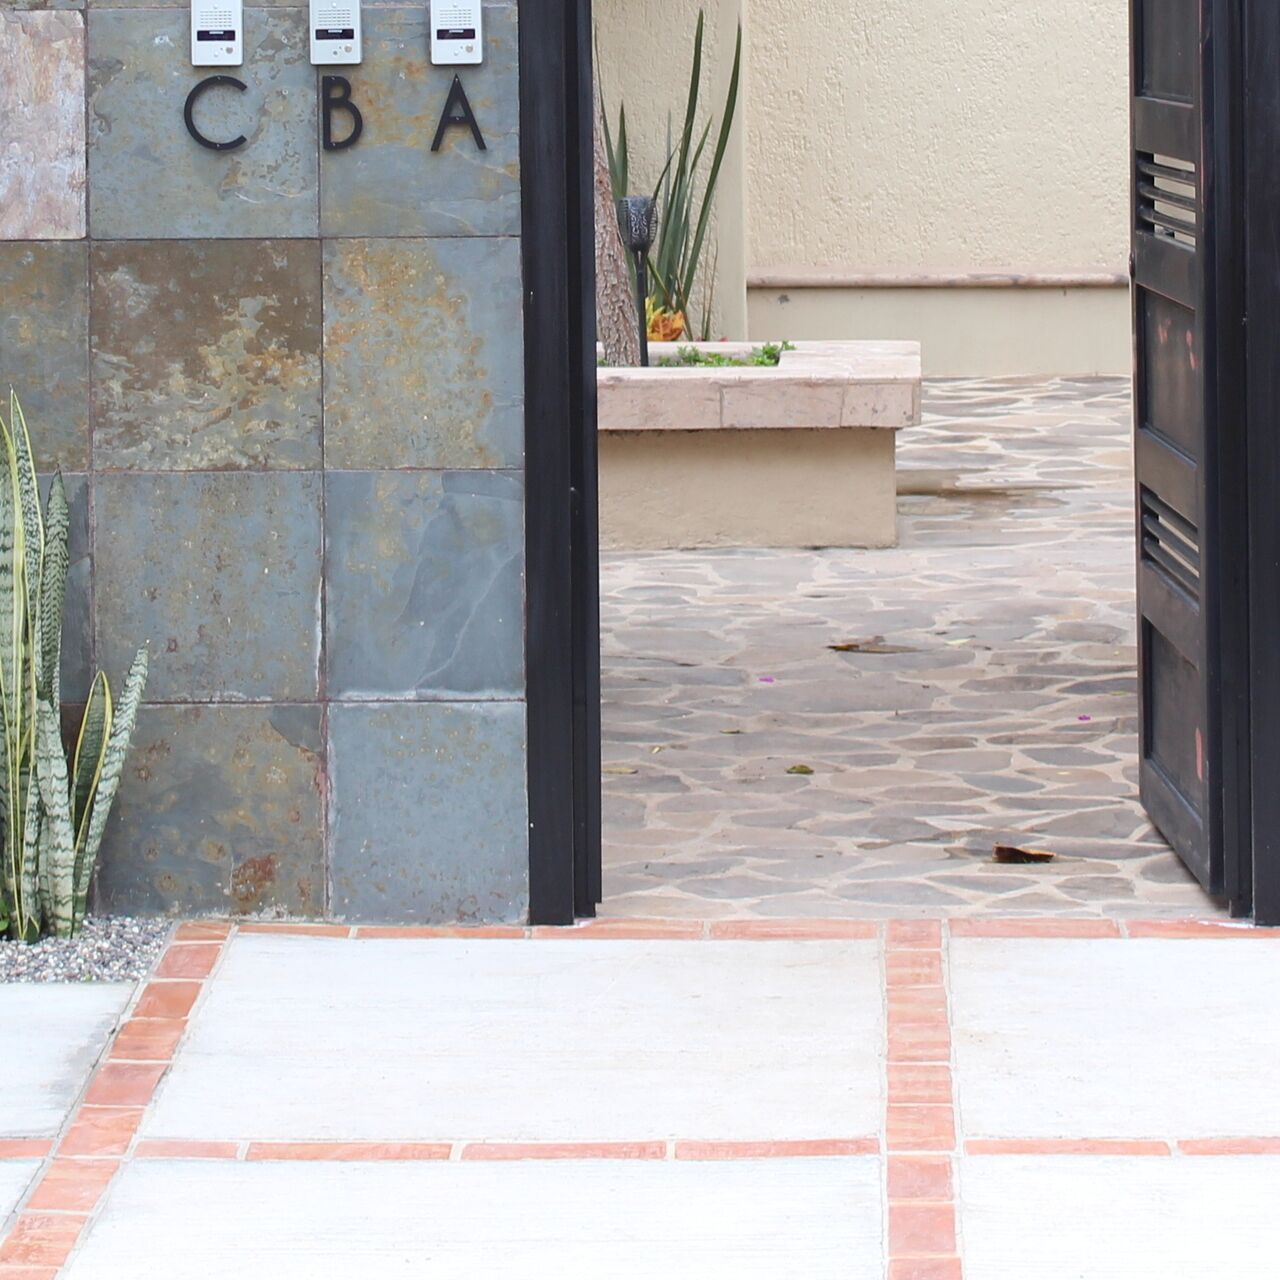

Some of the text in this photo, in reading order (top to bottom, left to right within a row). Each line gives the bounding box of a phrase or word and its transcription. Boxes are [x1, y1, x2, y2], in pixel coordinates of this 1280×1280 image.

[184, 75, 248, 151] C
[322, 75, 363, 151] B
[431, 74, 487, 152] A
